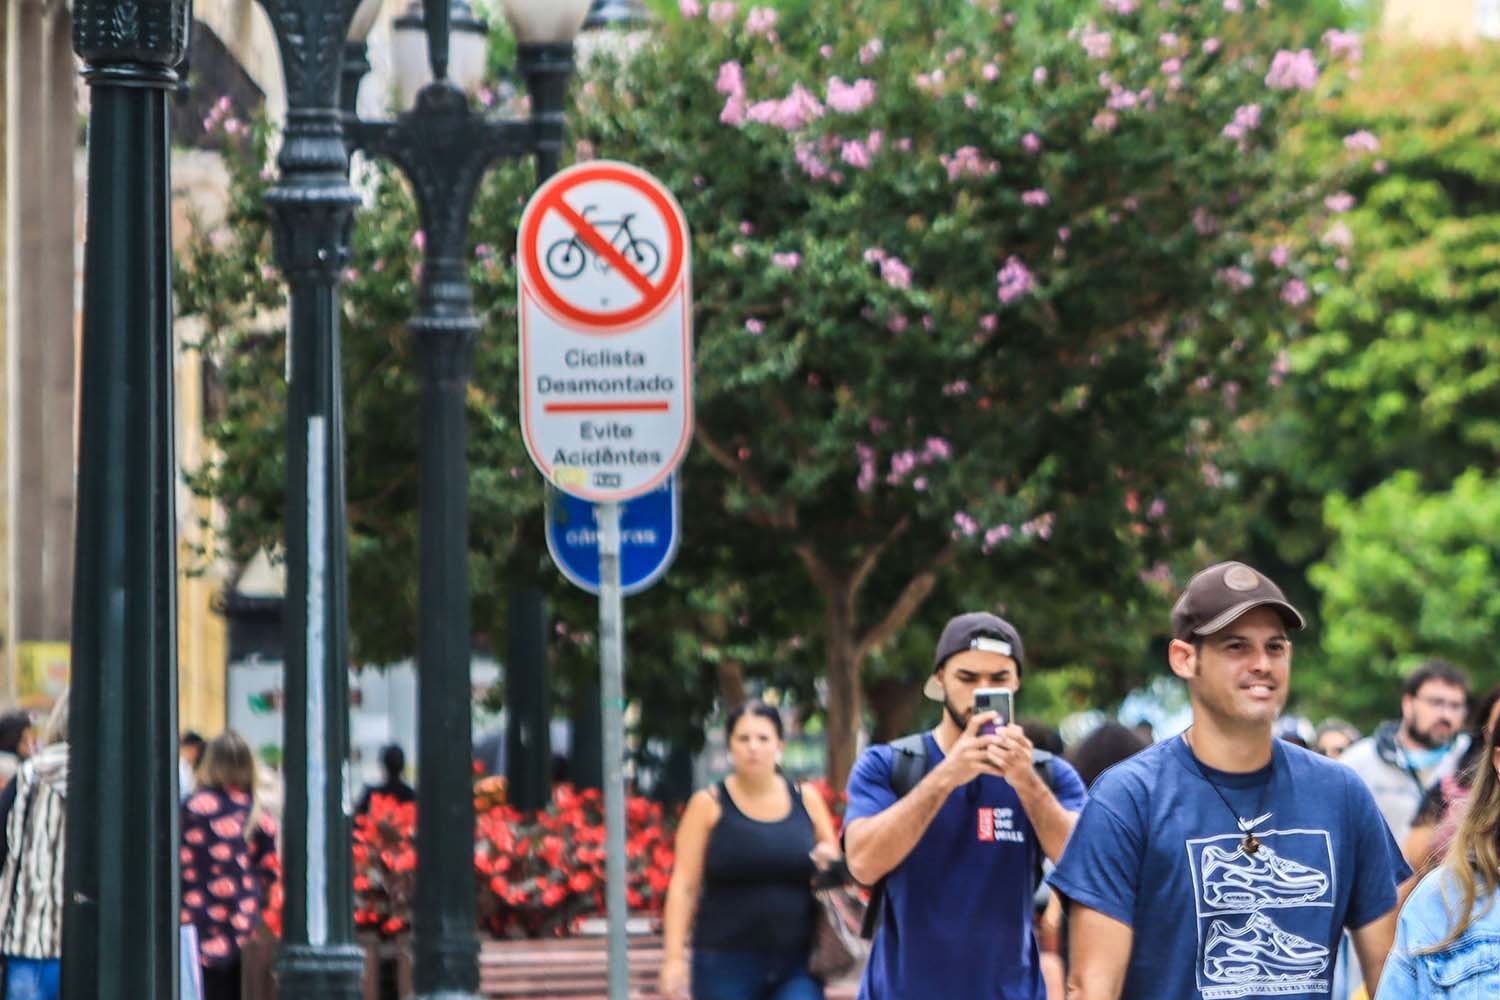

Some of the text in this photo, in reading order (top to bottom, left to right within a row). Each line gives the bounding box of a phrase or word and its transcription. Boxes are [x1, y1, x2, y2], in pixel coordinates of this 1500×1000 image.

[564, 348, 645, 368] Ciclista
[536, 374, 674, 394] Desmontado
[579, 421, 633, 440] Evite
